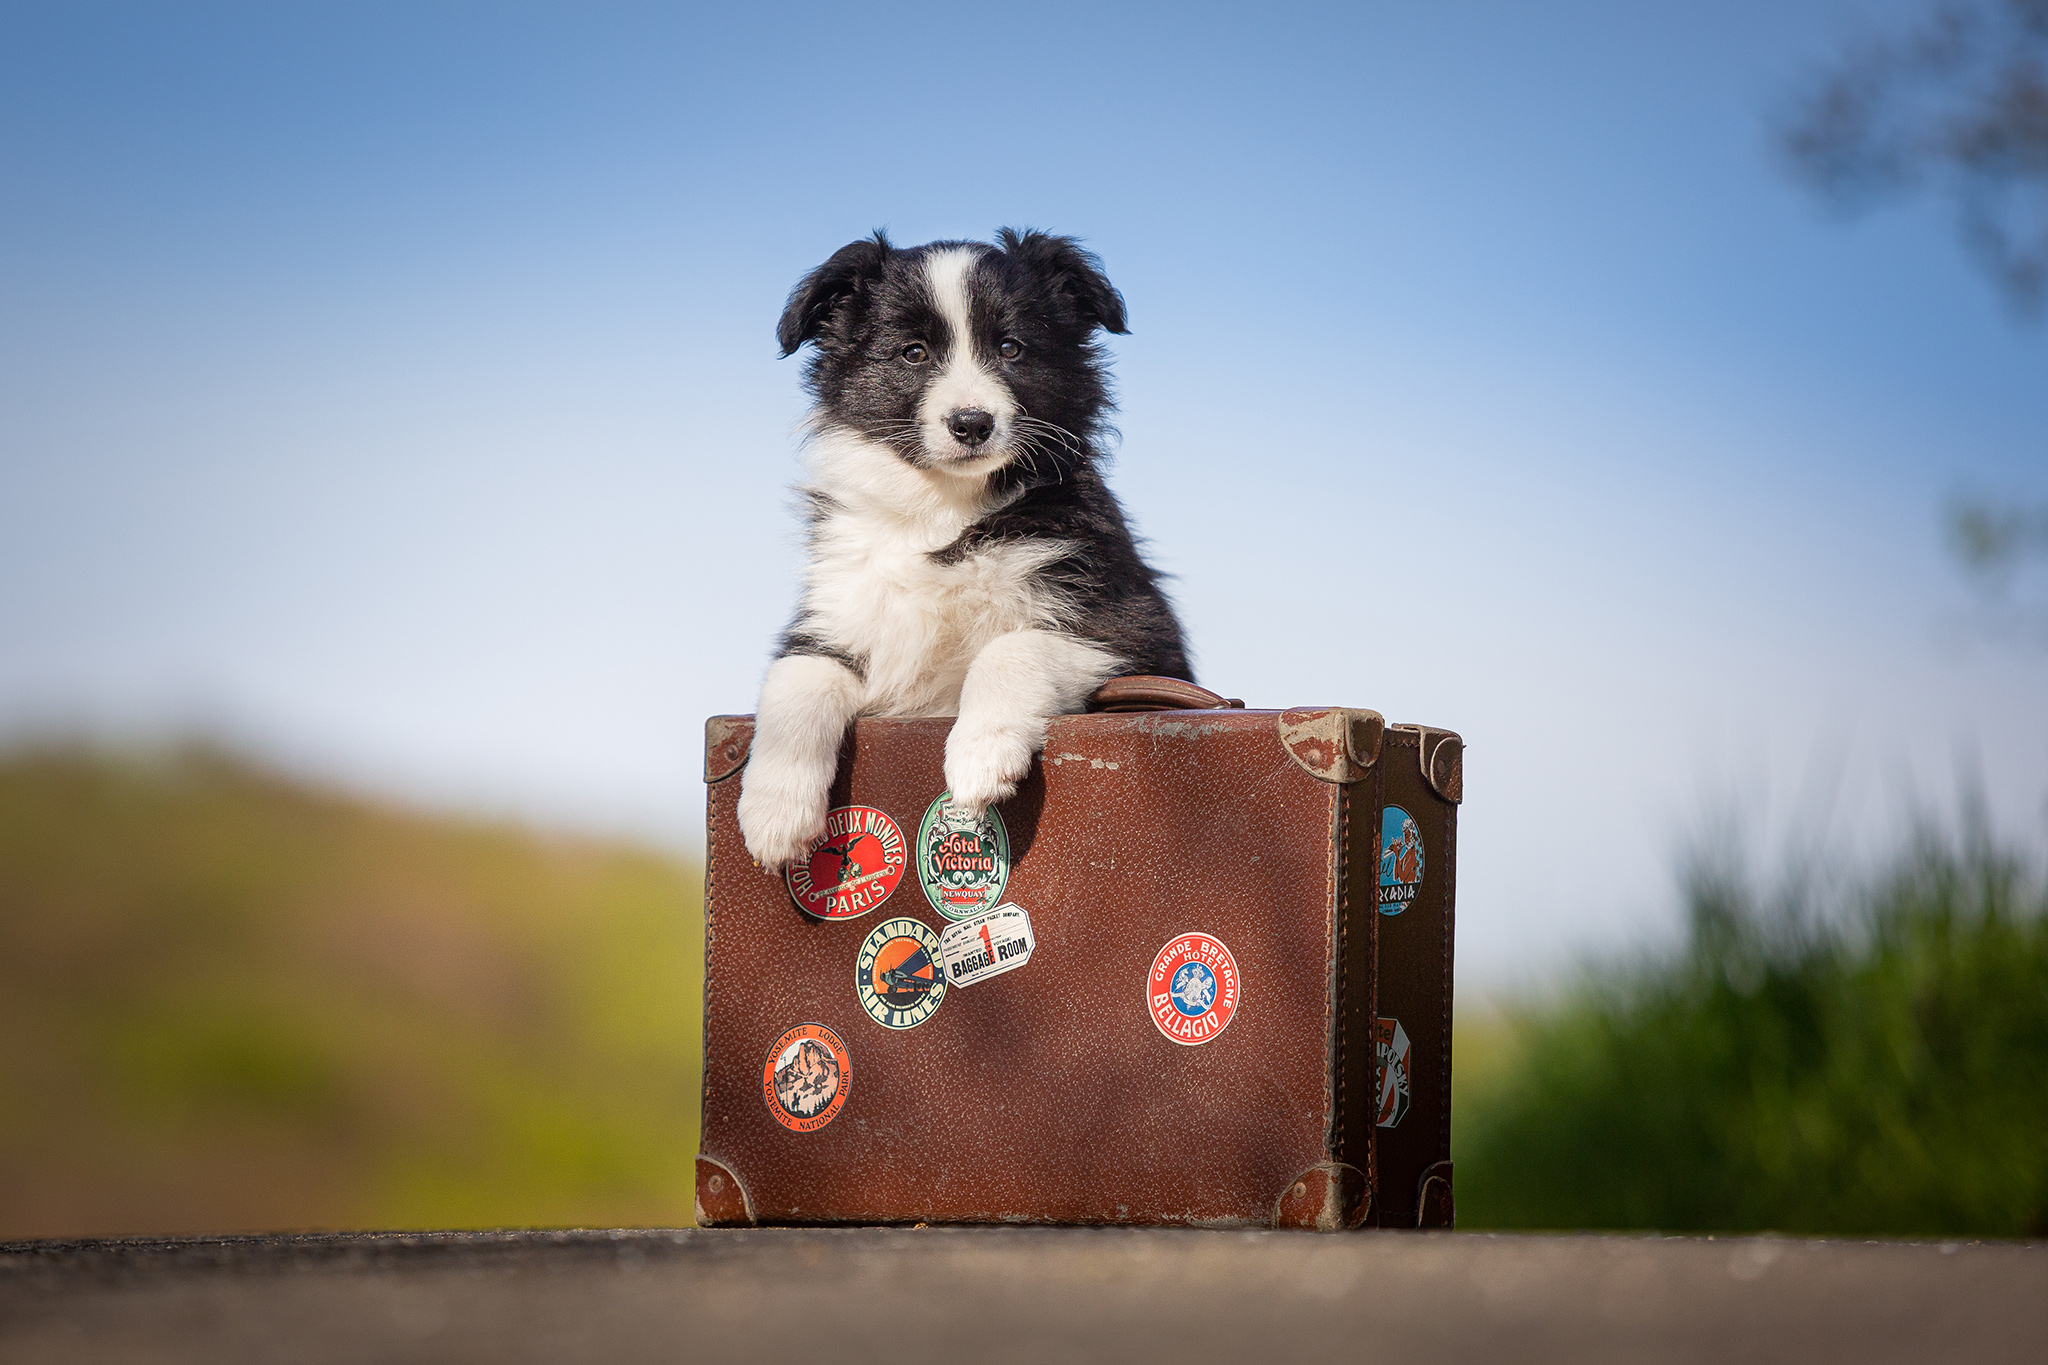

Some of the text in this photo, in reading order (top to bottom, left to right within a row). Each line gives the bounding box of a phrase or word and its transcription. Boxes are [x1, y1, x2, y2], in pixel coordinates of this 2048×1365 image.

[829, 811, 862, 837] DEUX
[865, 811, 903, 866] MONDES
[933, 852, 993, 876] Victoria
[826, 880, 886, 914] PARIS
[943, 891, 985, 900] NEWQUAY
[860, 922, 943, 970] STANDARD
[943, 937, 951, 945] THE
[973, 919, 985, 927] STEAM
[978, 924, 996, 965] 1
[951, 950, 996, 979] BAGGAGE
[997, 937, 1028, 962] ROOM
[1155, 941, 1235, 1009] GRANDE BRETAGNE
[860, 982, 944, 1026] AIR LINES
[1153, 992, 1219, 1038] BELLAGIO
[768, 1027, 844, 1065] YOSEMITE LODGE
[764, 1069, 850, 1130] YOSEMITE NATIONAL PARK
